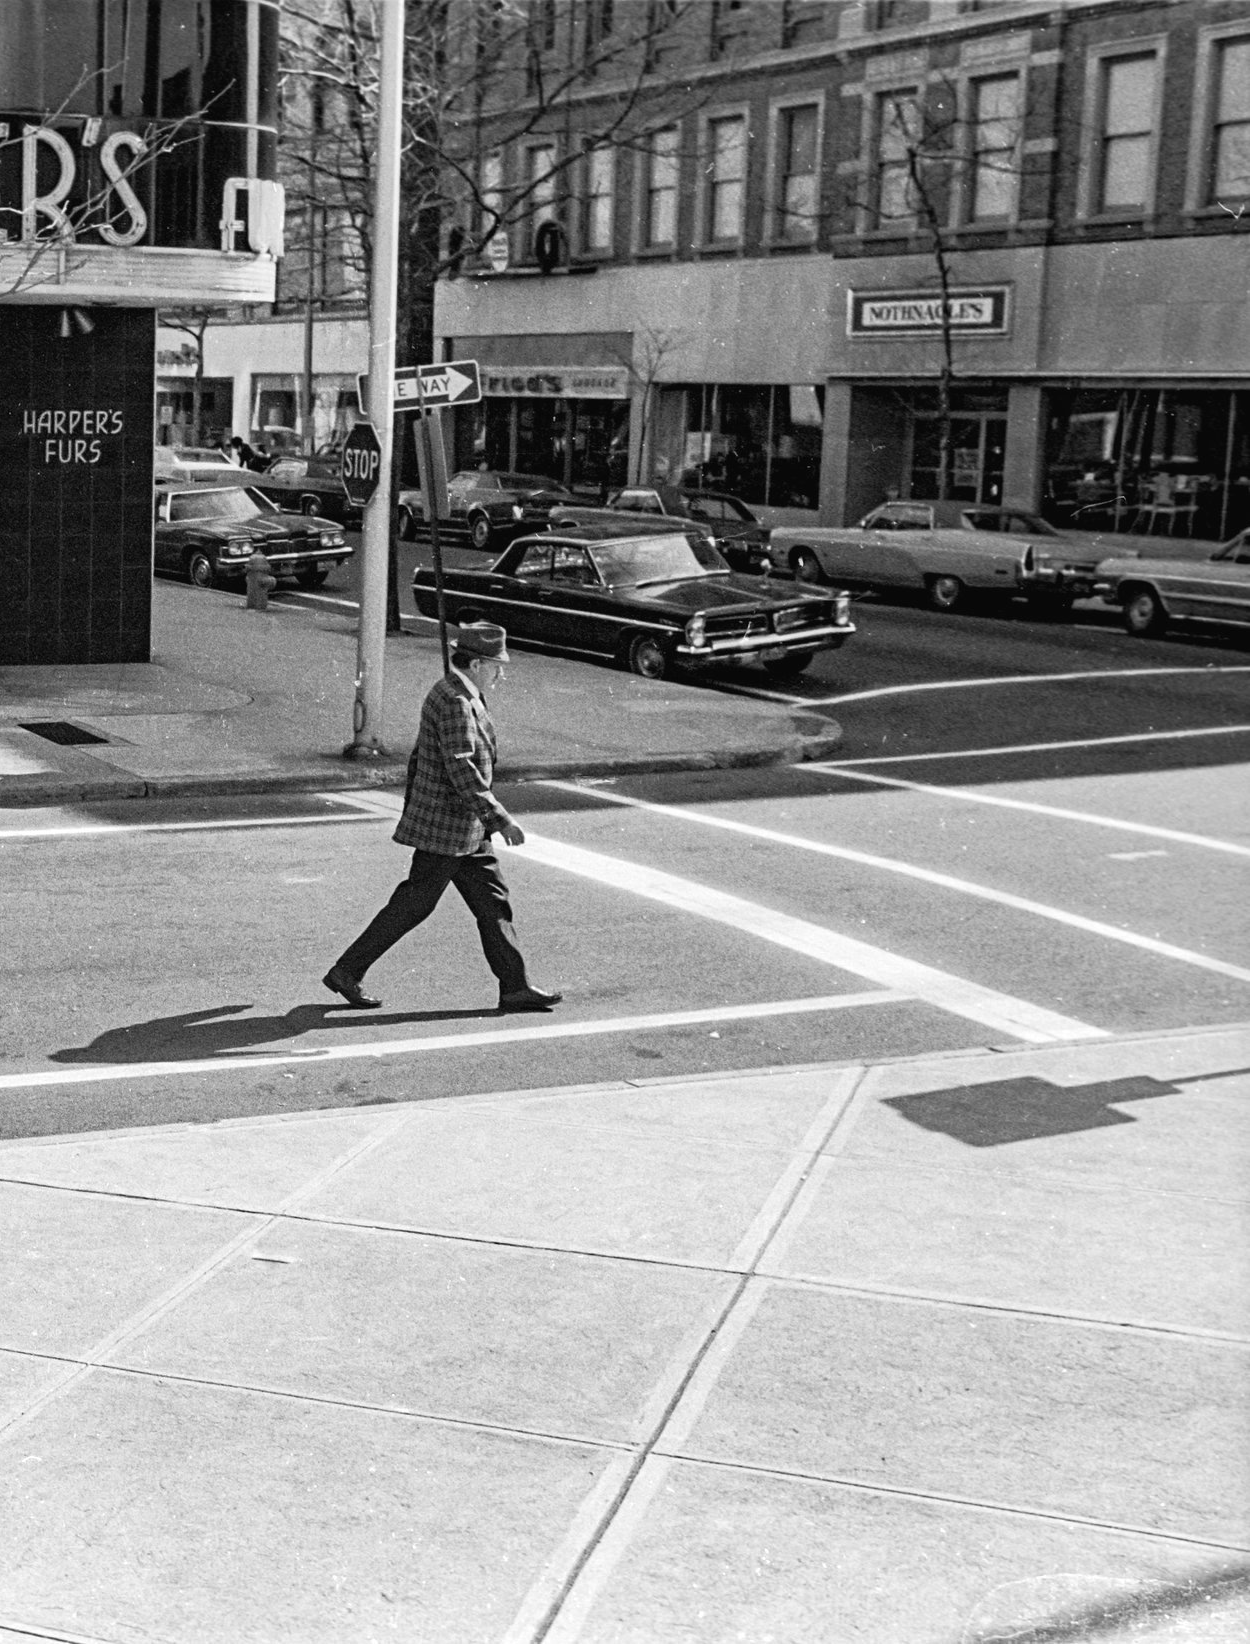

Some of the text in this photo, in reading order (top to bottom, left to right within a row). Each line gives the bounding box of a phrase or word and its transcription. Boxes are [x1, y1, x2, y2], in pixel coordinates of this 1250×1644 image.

[23, 409, 123, 434] HARPER'S
[45, 440, 101, 463] FURS
[344, 447, 379, 481] STOP
